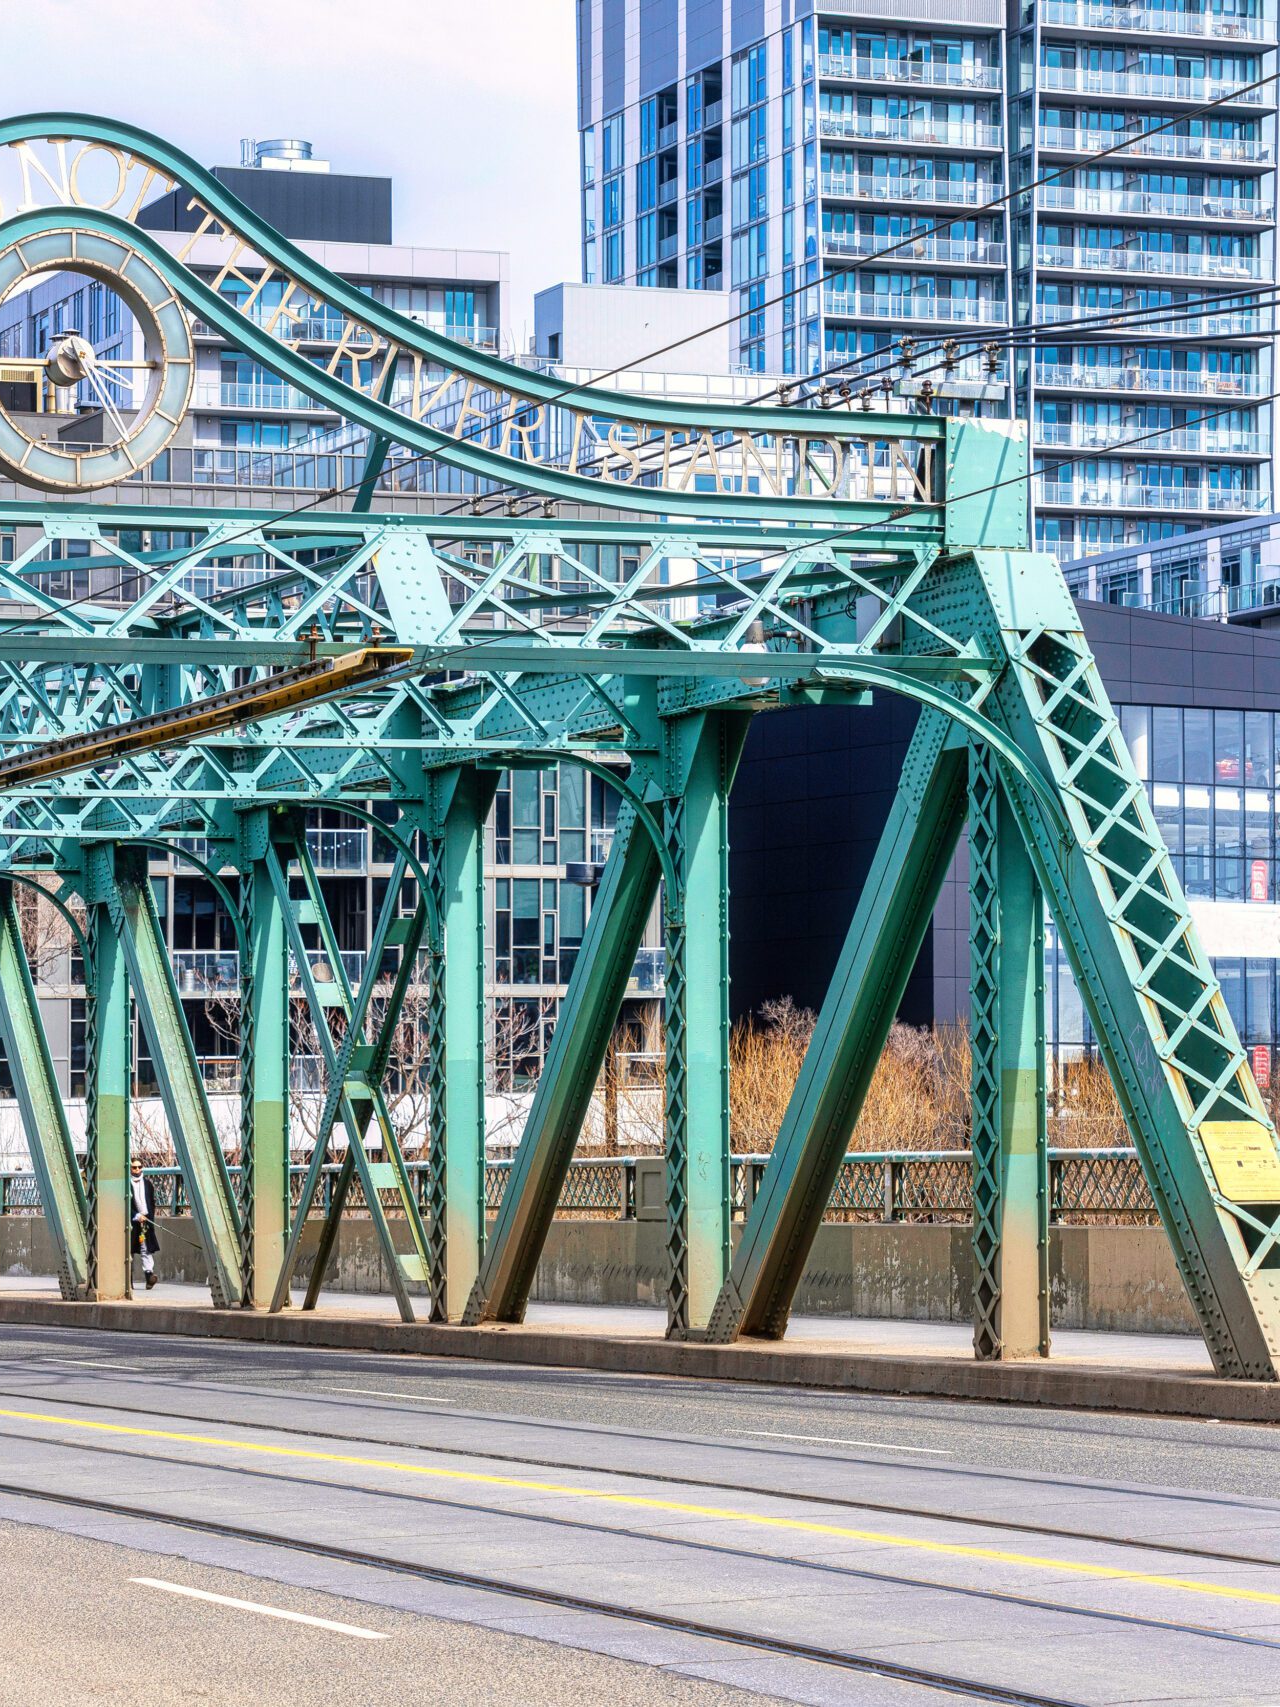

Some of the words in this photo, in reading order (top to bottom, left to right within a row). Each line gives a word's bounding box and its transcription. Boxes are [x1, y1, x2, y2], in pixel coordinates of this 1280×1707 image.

[8, 137, 176, 224] NOT
[177, 197, 323, 353] THE
[326, 317, 546, 464] RIVER
[568, 408, 594, 476] I
[602, 420, 847, 500] STAND
[865, 438, 939, 503] IN
